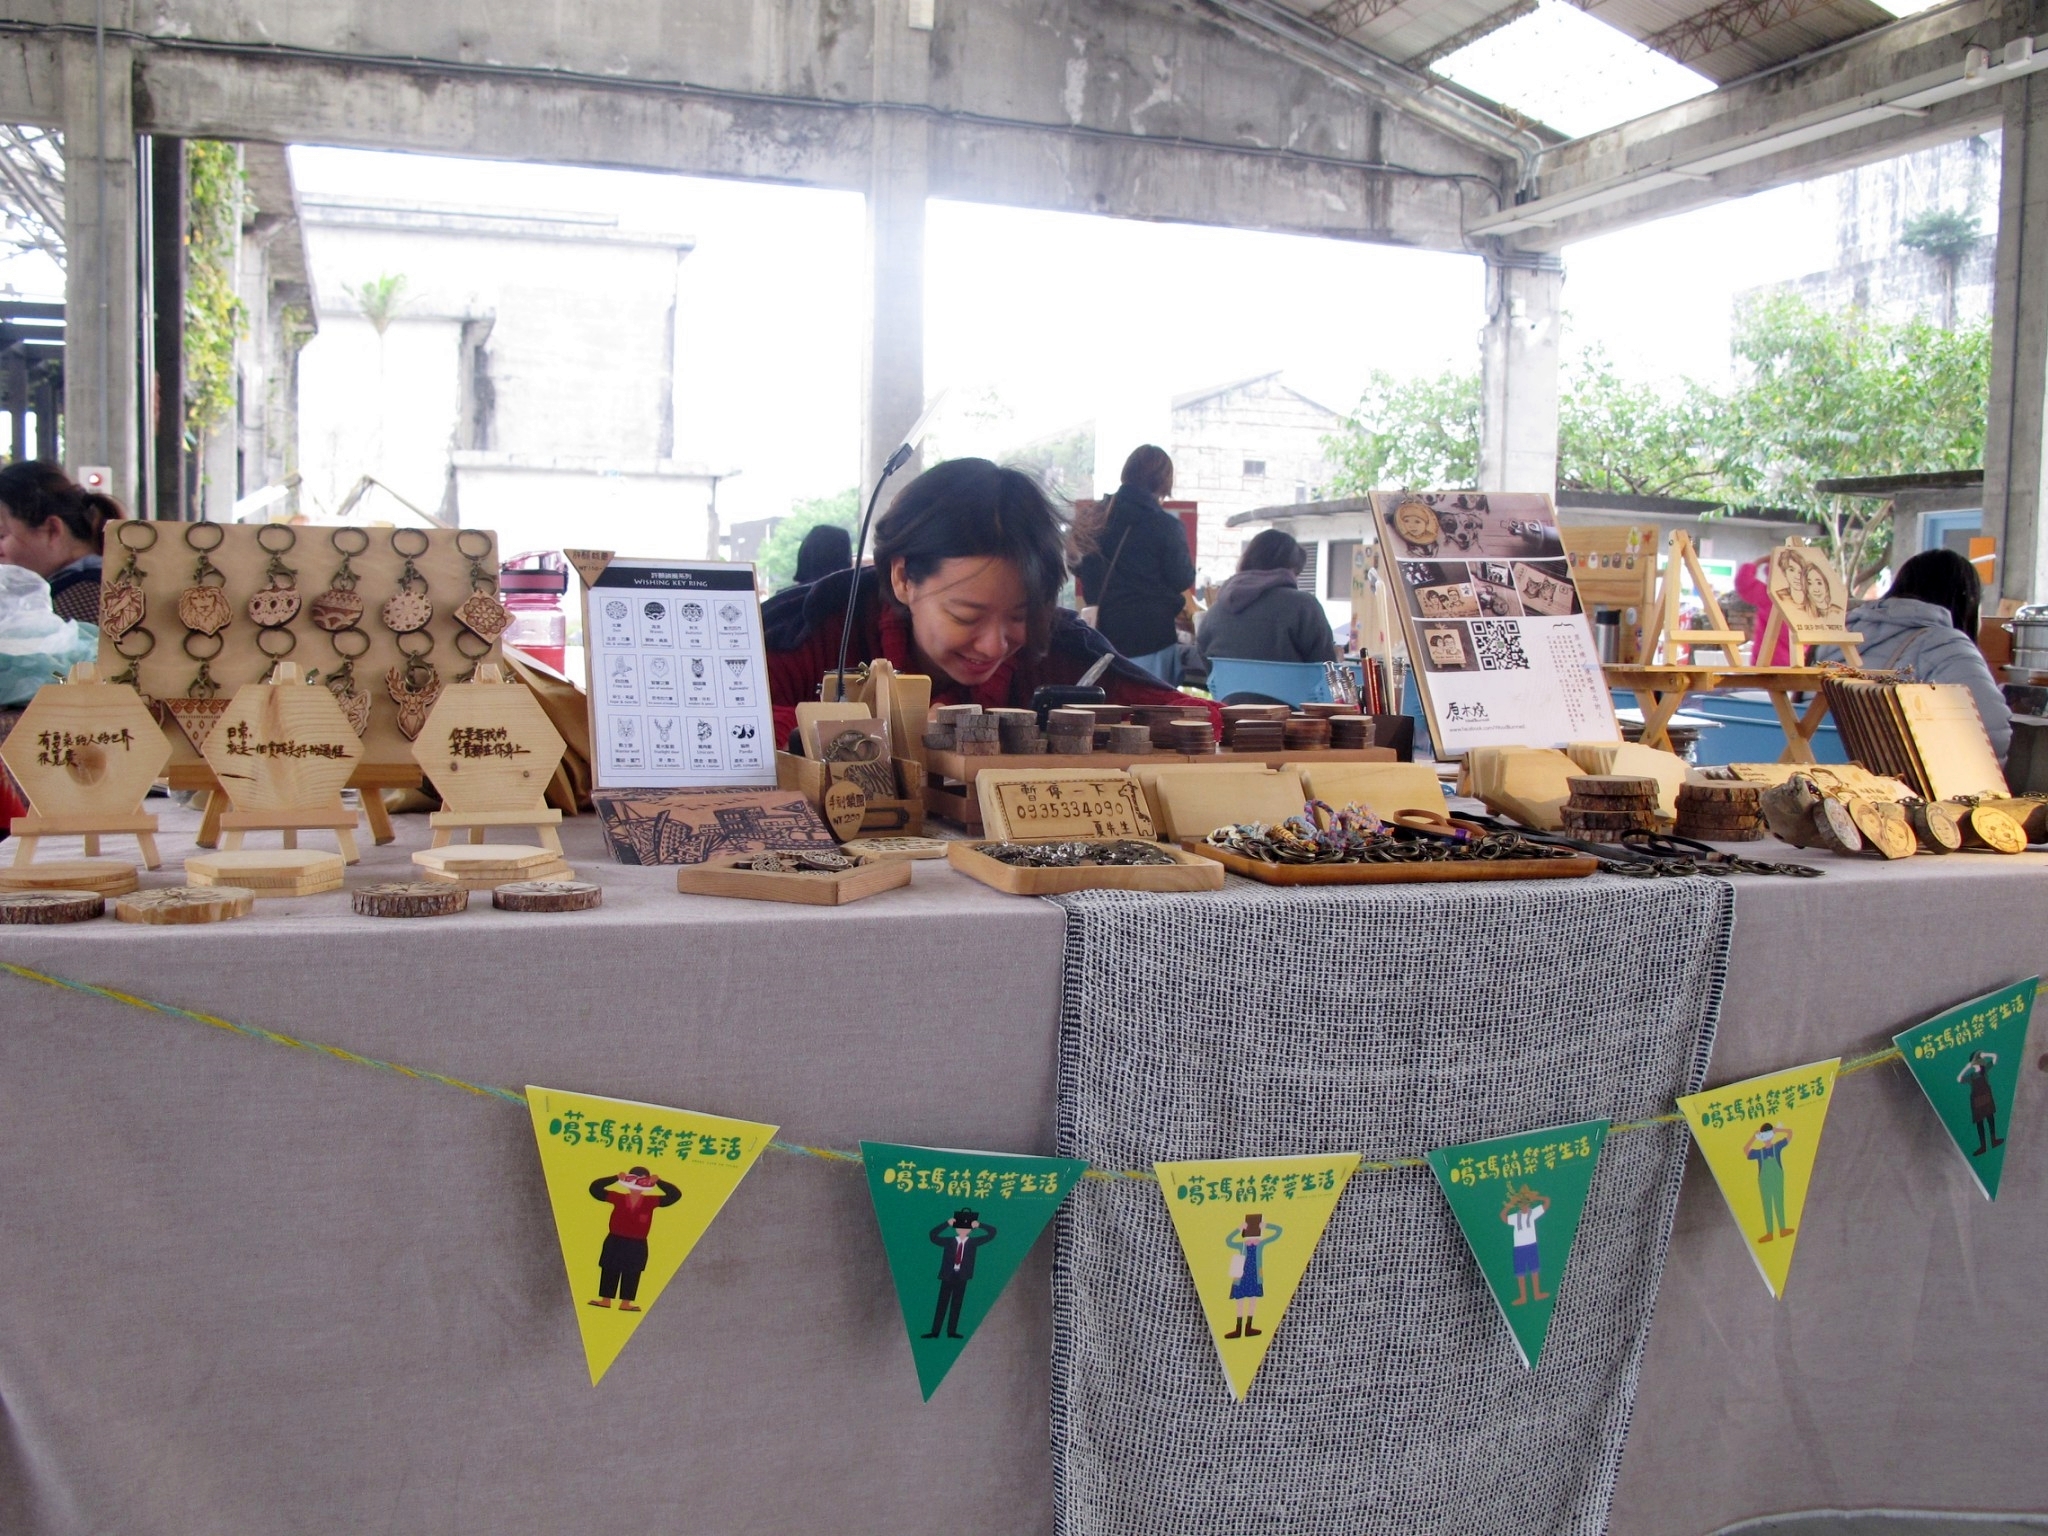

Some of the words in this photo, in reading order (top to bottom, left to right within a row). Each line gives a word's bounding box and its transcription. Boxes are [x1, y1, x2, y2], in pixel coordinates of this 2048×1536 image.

[634, 578, 671, 586] WISHING
[672, 579, 686, 587] KEY
[689, 580, 708, 588] RING
[1446, 702, 1489, 722] 原木燒
[1020, 783, 1107, 802] 暫停一下
[1016, 800, 1124, 819] 0935334090
[1092, 820, 1133, 838] 夏先生
[549, 1109, 742, 1161] 噶瑪蘭築夢生活
[1450, 1135, 1591, 1187] 噶瑪蘭築夢生活
[884, 1160, 1058, 1200] 噶瑪蘭築夢生活
[1177, 1168, 1335, 1206] 噶瑪蘭築夢生活
